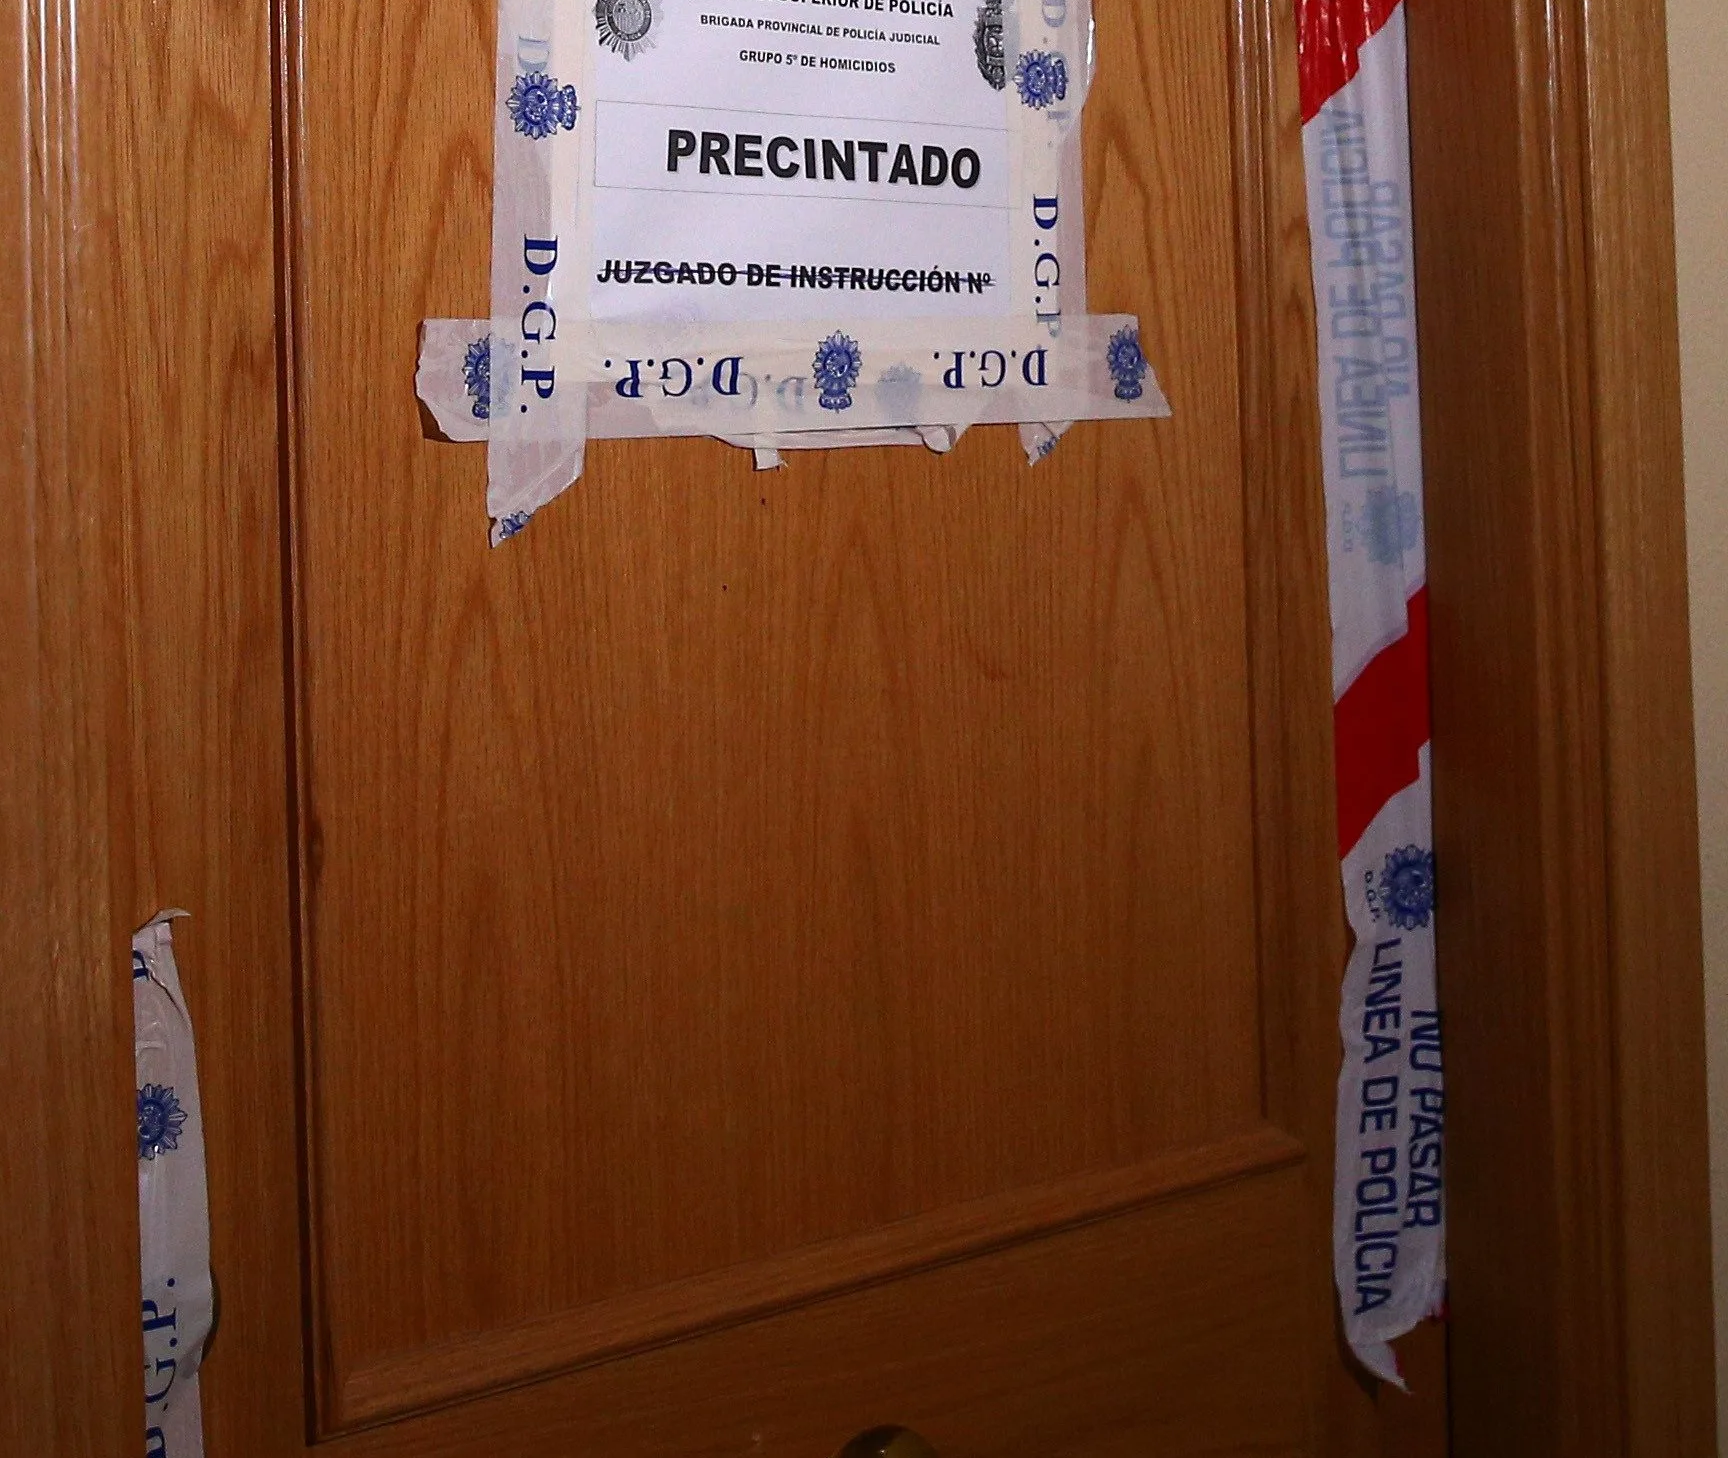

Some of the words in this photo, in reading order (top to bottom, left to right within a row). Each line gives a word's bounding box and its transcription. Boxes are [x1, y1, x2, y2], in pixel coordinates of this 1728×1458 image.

[701, 14, 754, 29] BRIGADA
[757, 20, 822, 35] PROVINCIAL
[826, 26, 840, 37] DE
[843, 27, 886, 42] POLICÍA
[889, 32, 940, 45] JUDICIAL
[739, 49, 783, 64] GRUPO
[801, 55, 816, 67] DE
[820, 57, 896, 74] HOMICIDIOS
[666, 128, 981, 189] PRECINTADO
[597, 259, 738, 286] JUZGADO
[746, 263, 781, 287] DE
[790, 265, 960, 294] INSTRUCCIÓN
[521, 233, 559, 413] D.G.P.
[604, 355, 746, 399] D.G.P.
[933, 348, 1049, 389] D.G.P.
[1363, 938, 1403, 1065] LINEA
[1359, 1075, 1399, 1134] DE
[1403, 1087, 1443, 1229] PASAR
[1353, 1146, 1399, 1316] POLICIA
